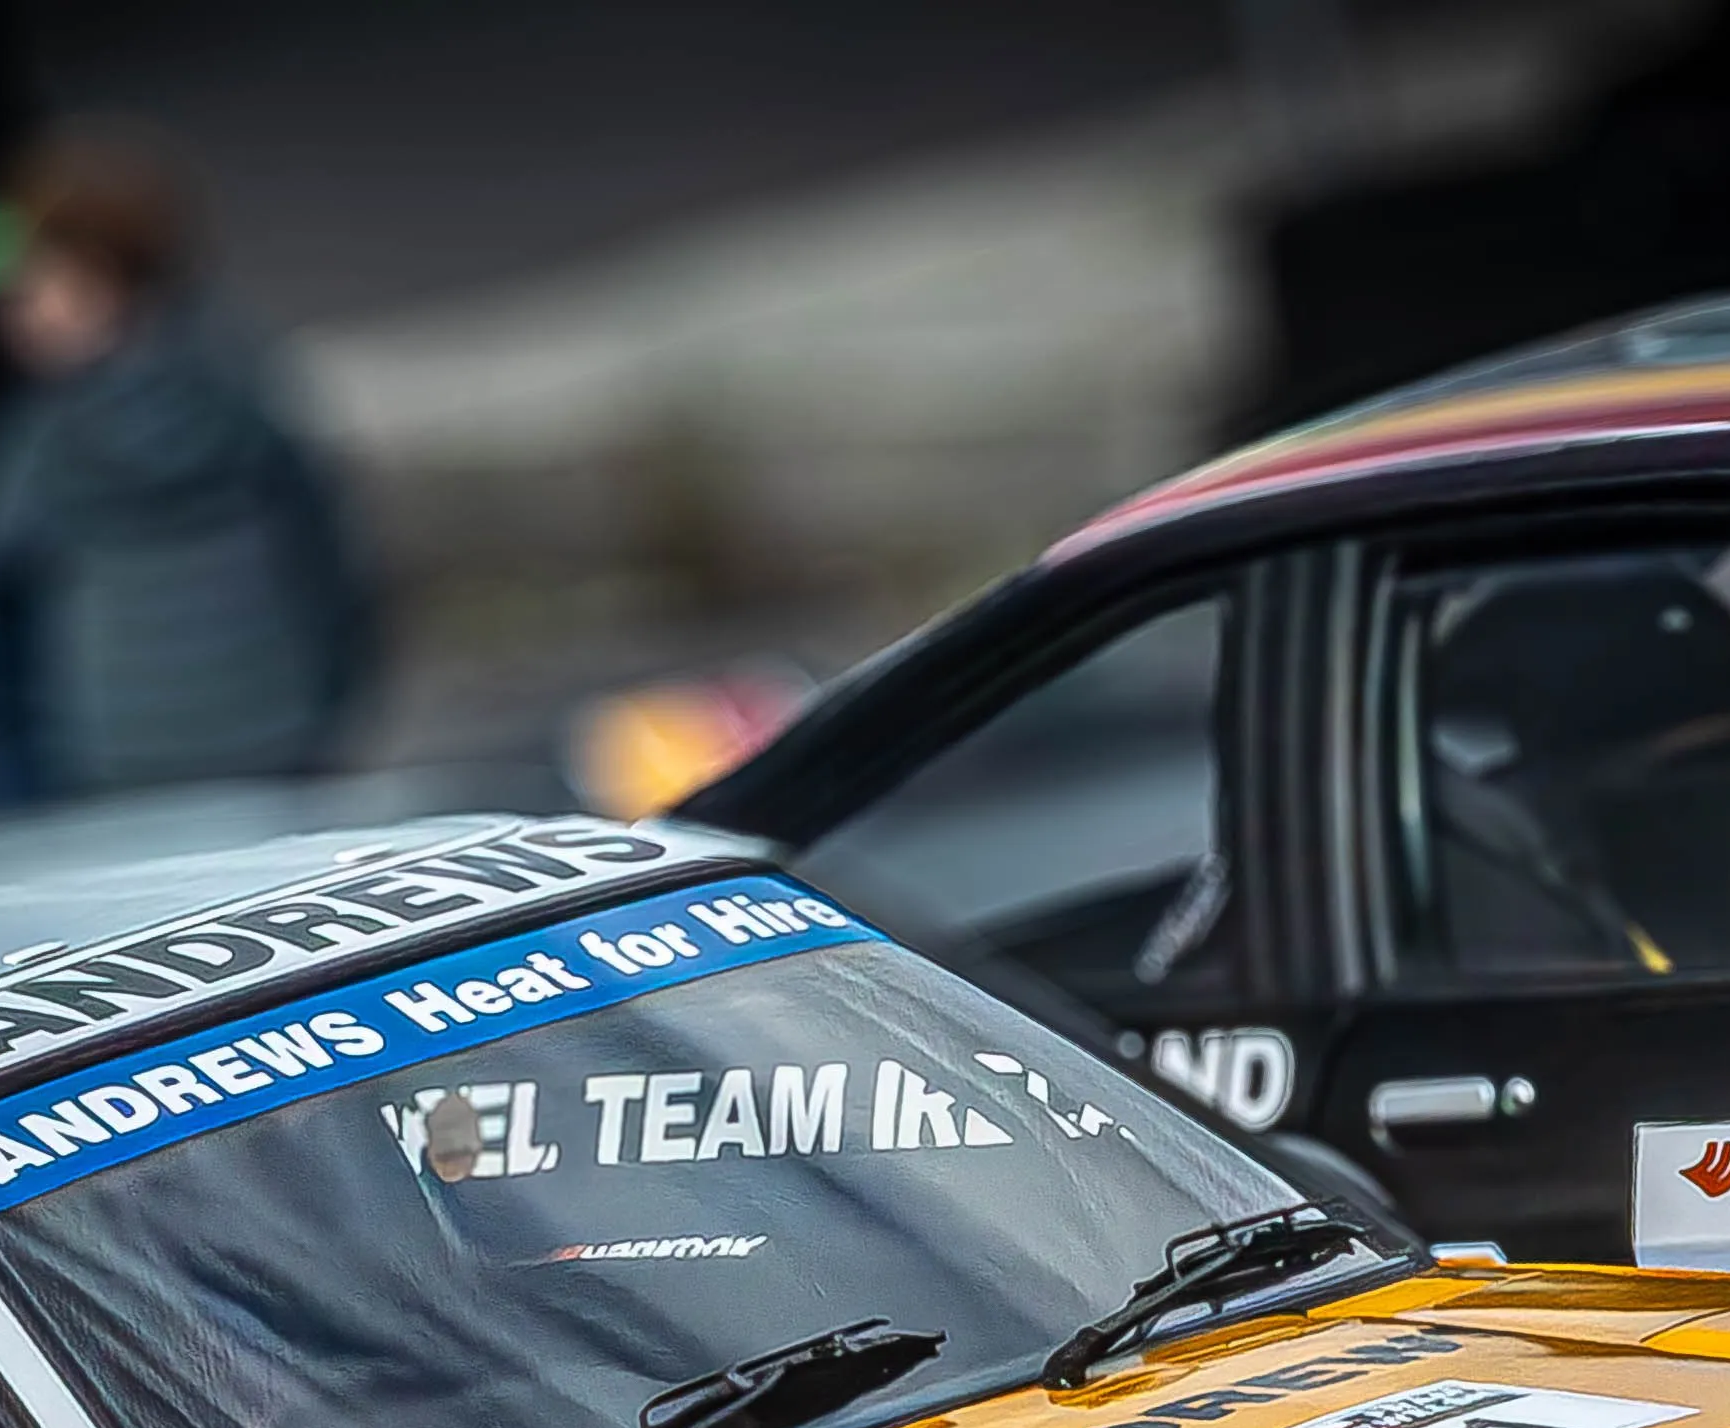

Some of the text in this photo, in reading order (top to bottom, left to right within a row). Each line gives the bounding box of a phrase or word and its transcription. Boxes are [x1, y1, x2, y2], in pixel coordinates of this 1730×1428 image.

[383, 952, 593, 1034] Heat
[581, 915, 695, 978] for
[688, 891, 850, 946] Hire
[586, 1063, 848, 1165] TEAM
